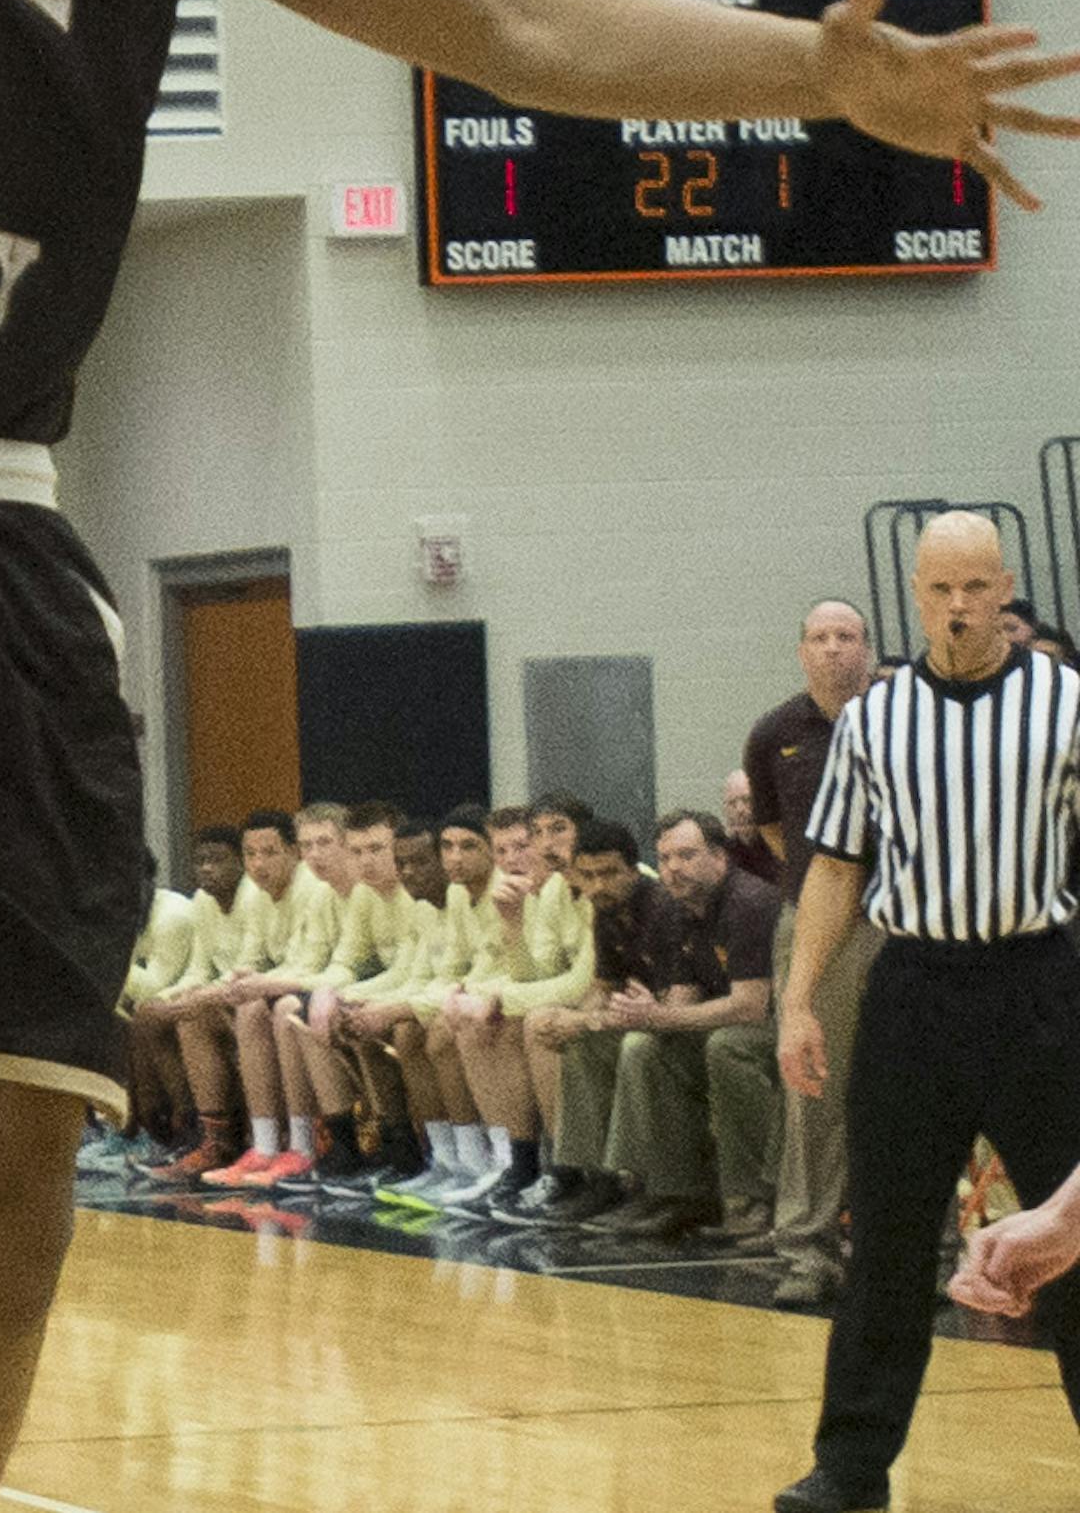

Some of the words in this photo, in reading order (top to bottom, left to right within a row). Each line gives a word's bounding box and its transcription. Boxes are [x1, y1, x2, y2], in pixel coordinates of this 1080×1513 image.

[444, 117, 534, 148] FOULS
[621, 118, 726, 144] PLAYER
[739, 116, 809, 141] FOUL
[504, 158, 517, 216] 1
[634, 150, 718, 217] 22
[778, 153, 790, 209] 1
[344, 186, 393, 228] EXIT
[446, 239, 537, 271] SCORE
[665, 235, 763, 265] MATCH
[894, 229, 982, 261] SCORE
